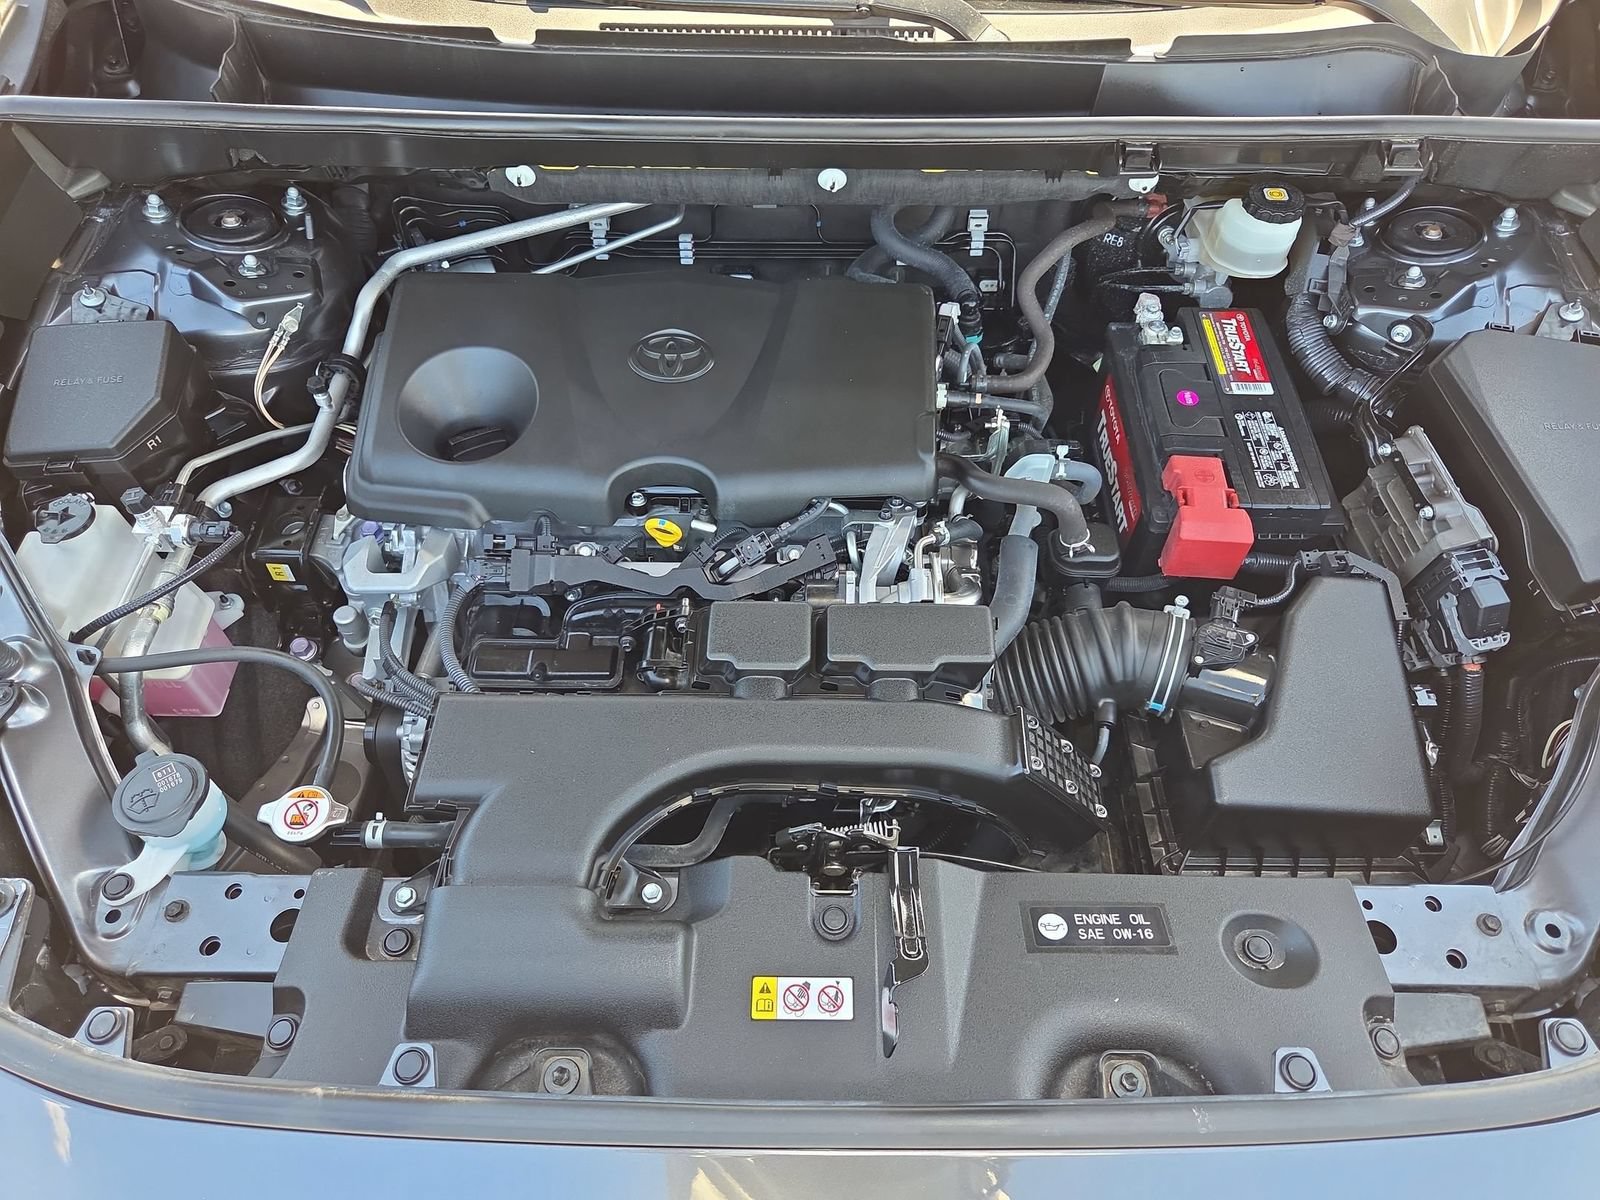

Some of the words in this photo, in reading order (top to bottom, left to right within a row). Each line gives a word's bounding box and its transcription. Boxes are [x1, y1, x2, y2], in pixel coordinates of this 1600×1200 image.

[1102, 232, 1124, 248] RE8
[1240, 321, 1252, 342] TOYOTA
[53, 378, 87, 386] RELAY
[97, 375, 123, 384] FUSE
[1543, 422, 1575, 431] RELAY
[1585, 422, 1600, 431] FU
[146, 435, 162, 451] R1
[1073, 913, 1122, 925] ENGINE
[1129, 913, 1151, 925] OIL
[1078, 928, 1105, 940] SAE
[1112, 928, 1154, 940] 0W-16
